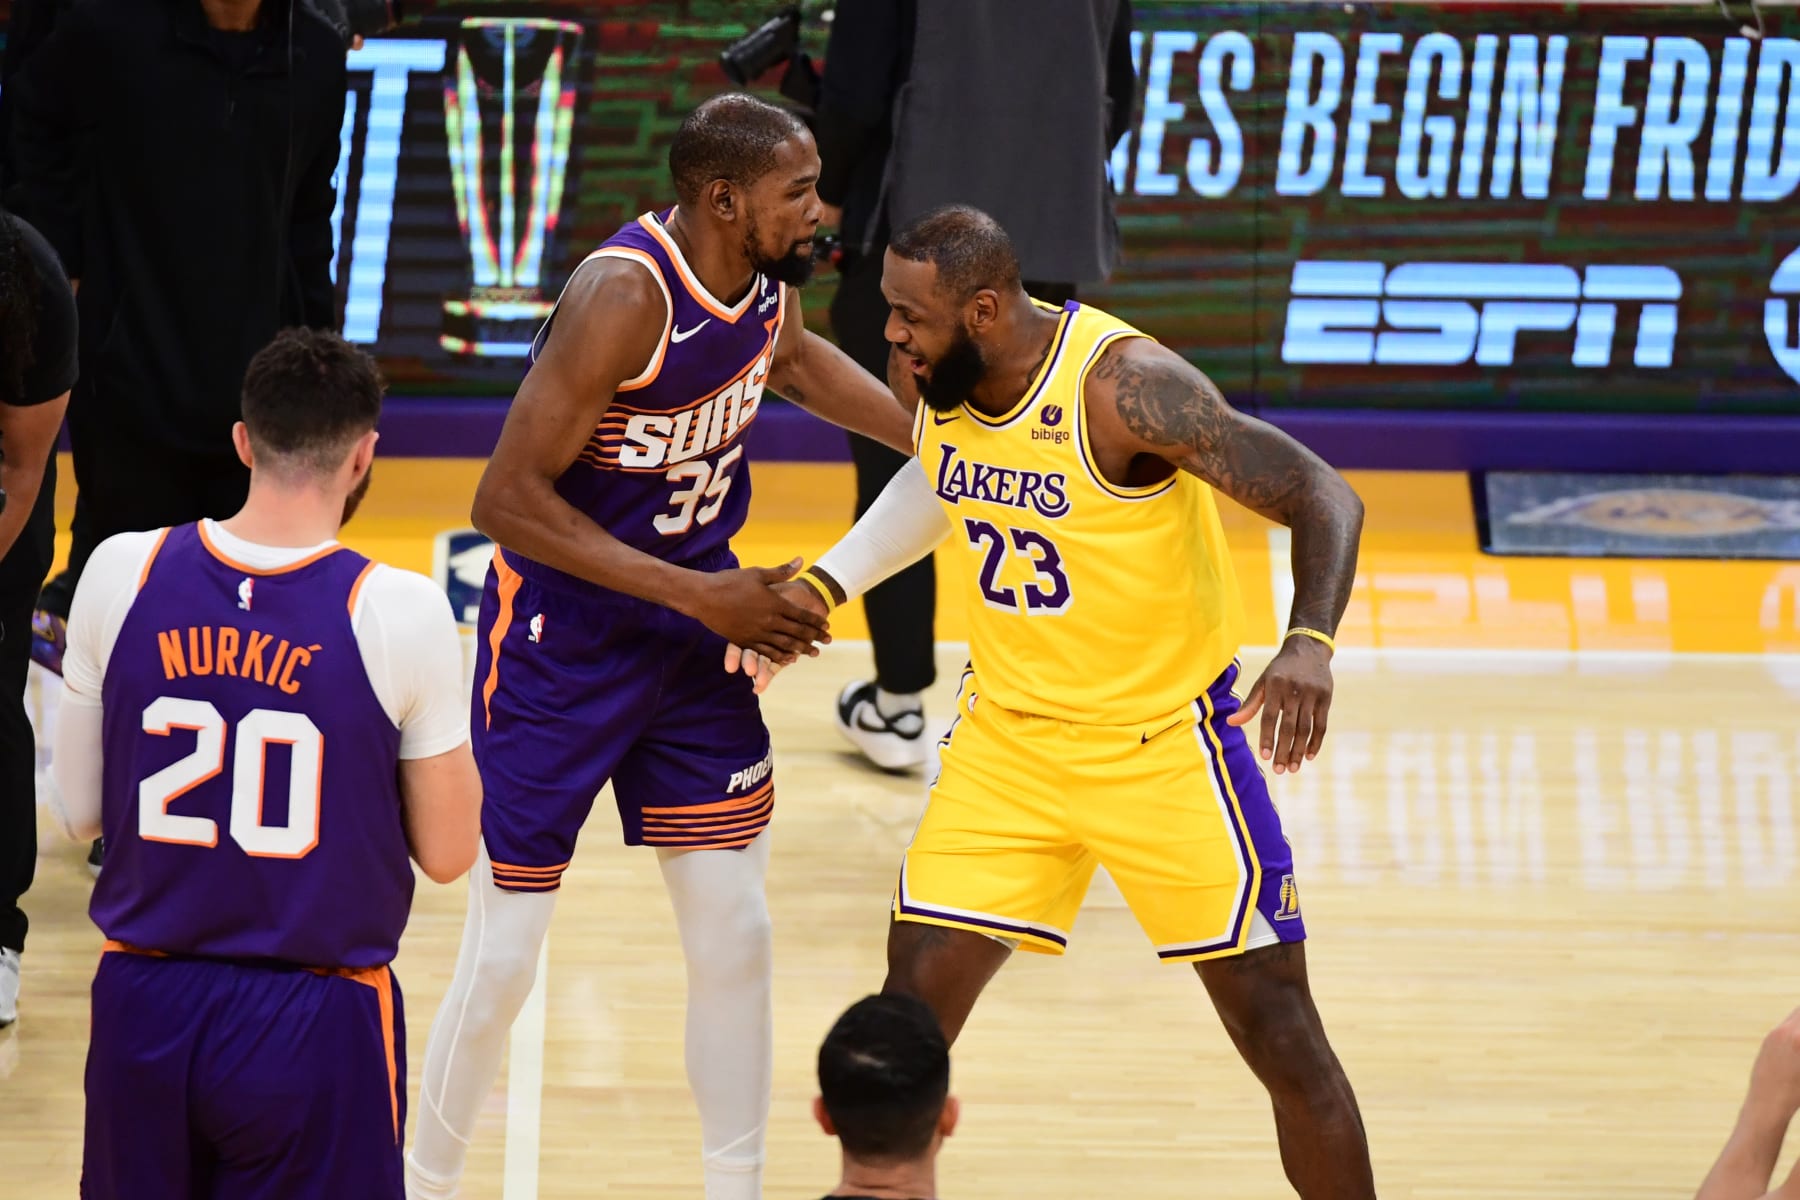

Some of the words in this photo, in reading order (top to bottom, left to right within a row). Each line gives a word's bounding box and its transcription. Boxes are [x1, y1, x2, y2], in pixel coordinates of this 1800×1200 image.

[1275, 31, 1569, 199] BEGIN
[1582, 35, 1800, 201] FRID
[1281, 260, 1683, 368] ESPN
[618, 355, 767, 468] SUNS
[1031, 427, 1070, 444] bibigo
[652, 443, 743, 536] 35
[935, 442, 1072, 520] LAKERS
[963, 516, 1075, 617] 23
[157, 625, 323, 695] NURKIĆ
[138, 695, 325, 860] 20
